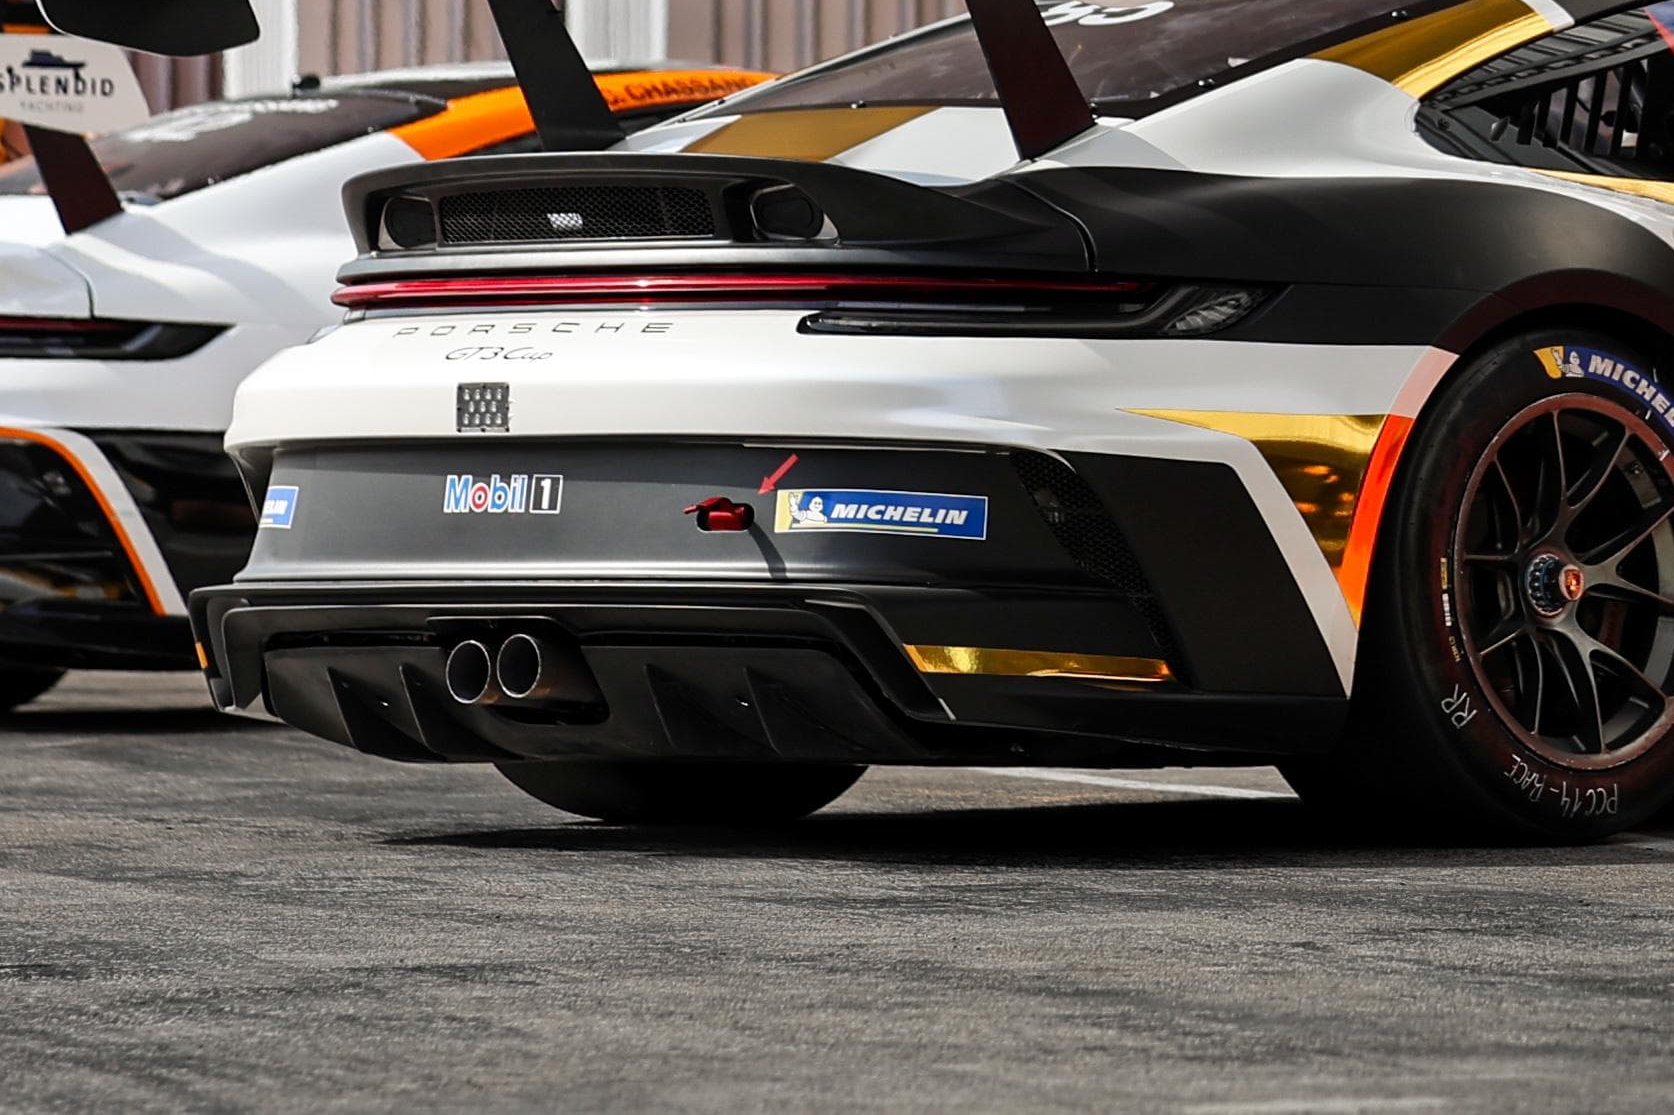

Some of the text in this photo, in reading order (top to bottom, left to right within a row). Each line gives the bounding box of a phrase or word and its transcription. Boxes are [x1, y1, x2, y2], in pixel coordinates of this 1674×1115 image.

[392, 321, 675, 338] PORSCHE
[443, 474, 529, 514] Mobil
[830, 503, 969, 526] MICHELIN
[1440, 683, 1479, 729] RR
